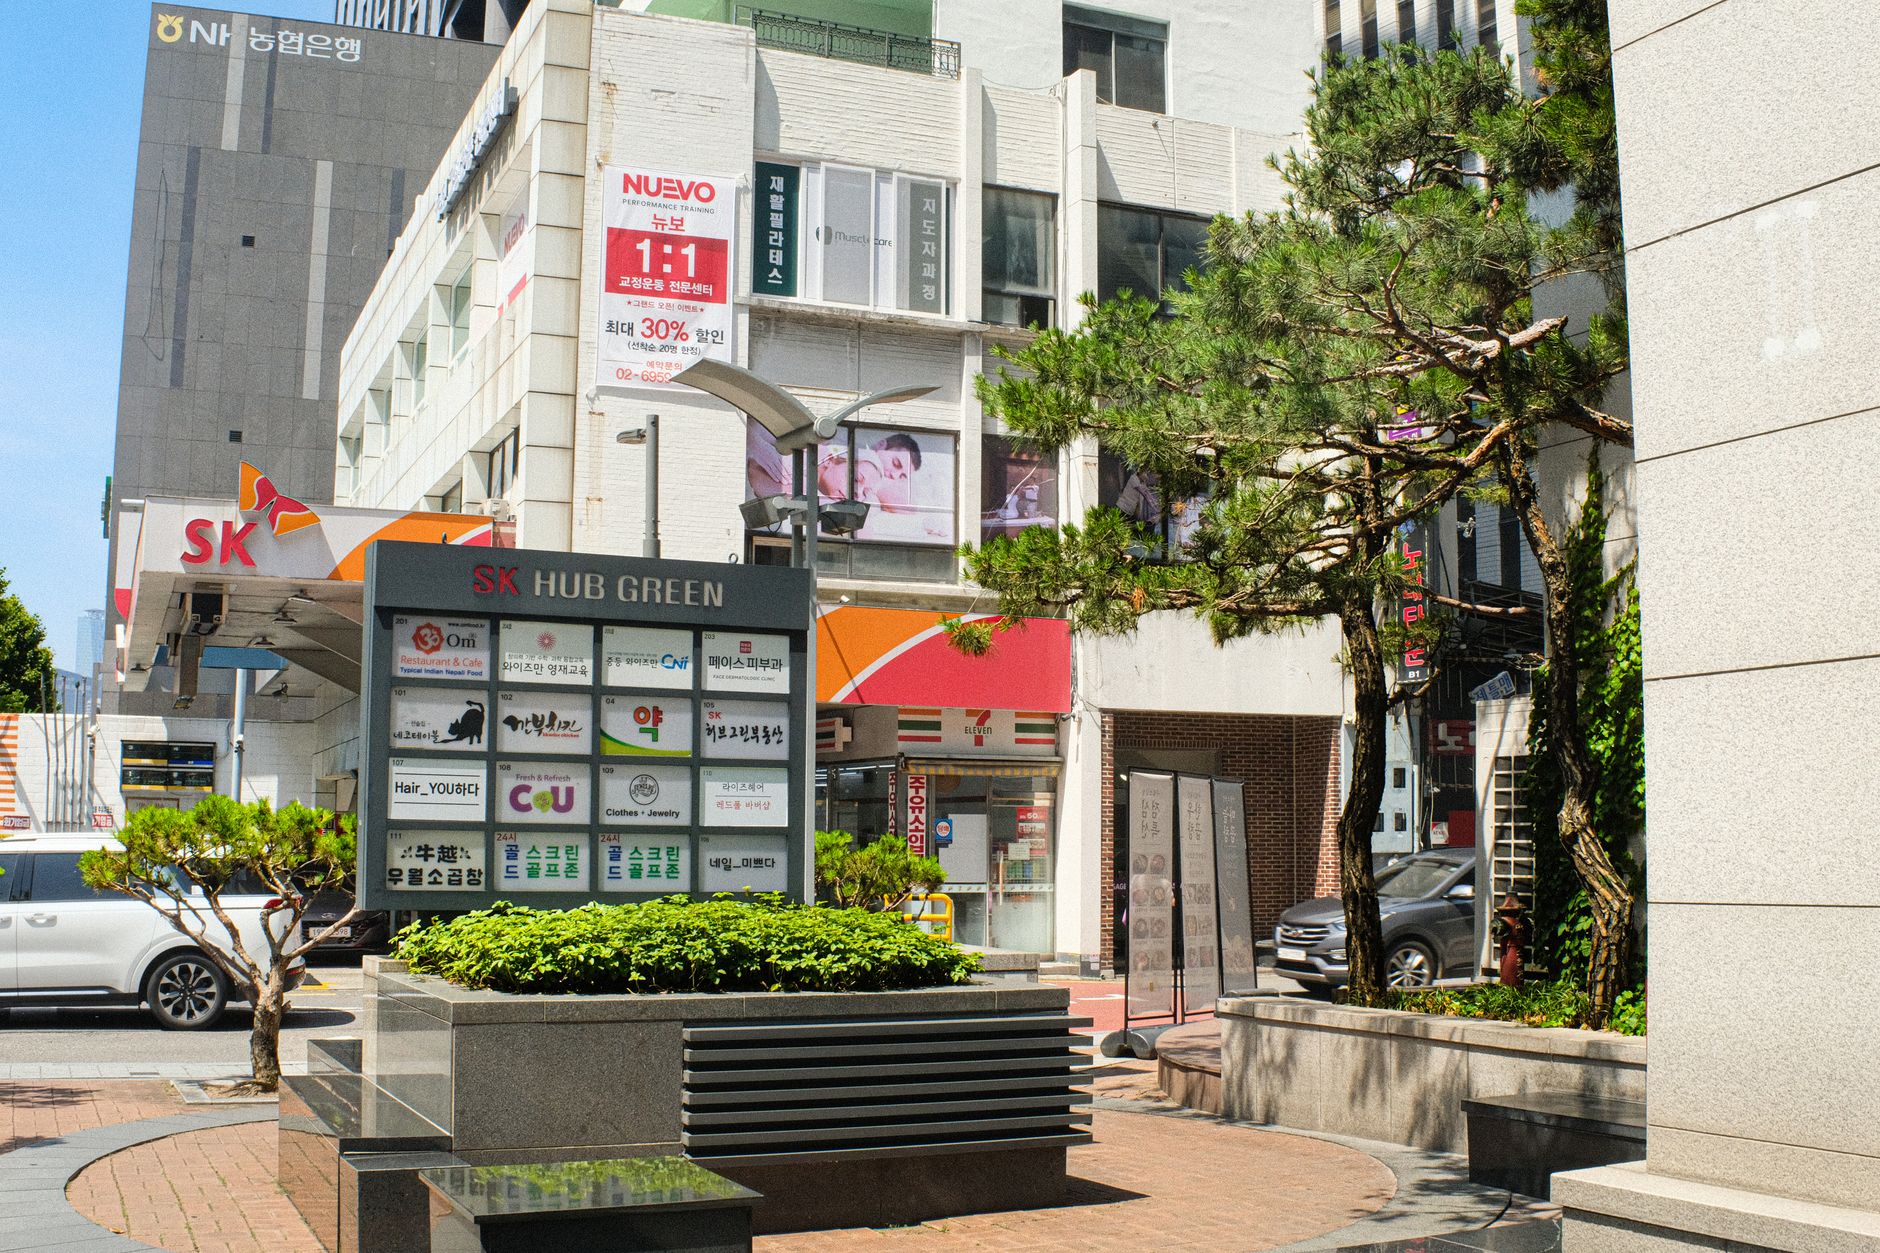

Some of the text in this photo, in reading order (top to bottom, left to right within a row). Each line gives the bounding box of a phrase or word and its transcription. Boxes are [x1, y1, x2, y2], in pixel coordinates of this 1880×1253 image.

[249, 27, 361, 62] 농협은행
[623, 173, 716, 203] NUEVO
[622, 199, 715, 214] PERFORMANCE TRAINING
[651, 214, 686, 232] 뉴보
[768, 176, 784, 285] 재활필라테스
[922, 198, 936, 300] 지도자과정
[636, 238, 696, 278] 1:1
[619, 276, 713, 296] 교정운동 전문센터
[605, 317, 724, 344] 최대 30% 할인
[180, 518, 258, 568] SK
[473, 565, 723, 607] SK HUB GREEN
[447, 633, 475, 648] Om
[401, 655, 483, 668] Restaurant & Cafe
[502, 662, 588, 677] 와이즈만 영재교육
[606, 656, 621, 668] 중등
[626, 657, 657, 669] 와이즈만
[708, 655, 783, 673] 페이스 피부과
[400, 667, 422, 675] Typical
[633, 705, 663, 742] 약
[708, 711, 721, 719] SK
[964, 726, 993, 735] ELEVEN
[395, 781, 480, 797] Hair_YOU하다
[509, 784, 575, 813] CU
[605, 808, 639, 817] Clothes
[647, 809, 680, 819] Jewelry
[496, 833, 517, 842] 24시
[600, 834, 620, 844] 24시
[526, 845, 579, 861] 스크린
[628, 846, 680, 862] 스크린
[388, 868, 483, 886] 우월소곱창
[526, 862, 580, 879] 골프존
[628, 863, 680, 880] 골프존
